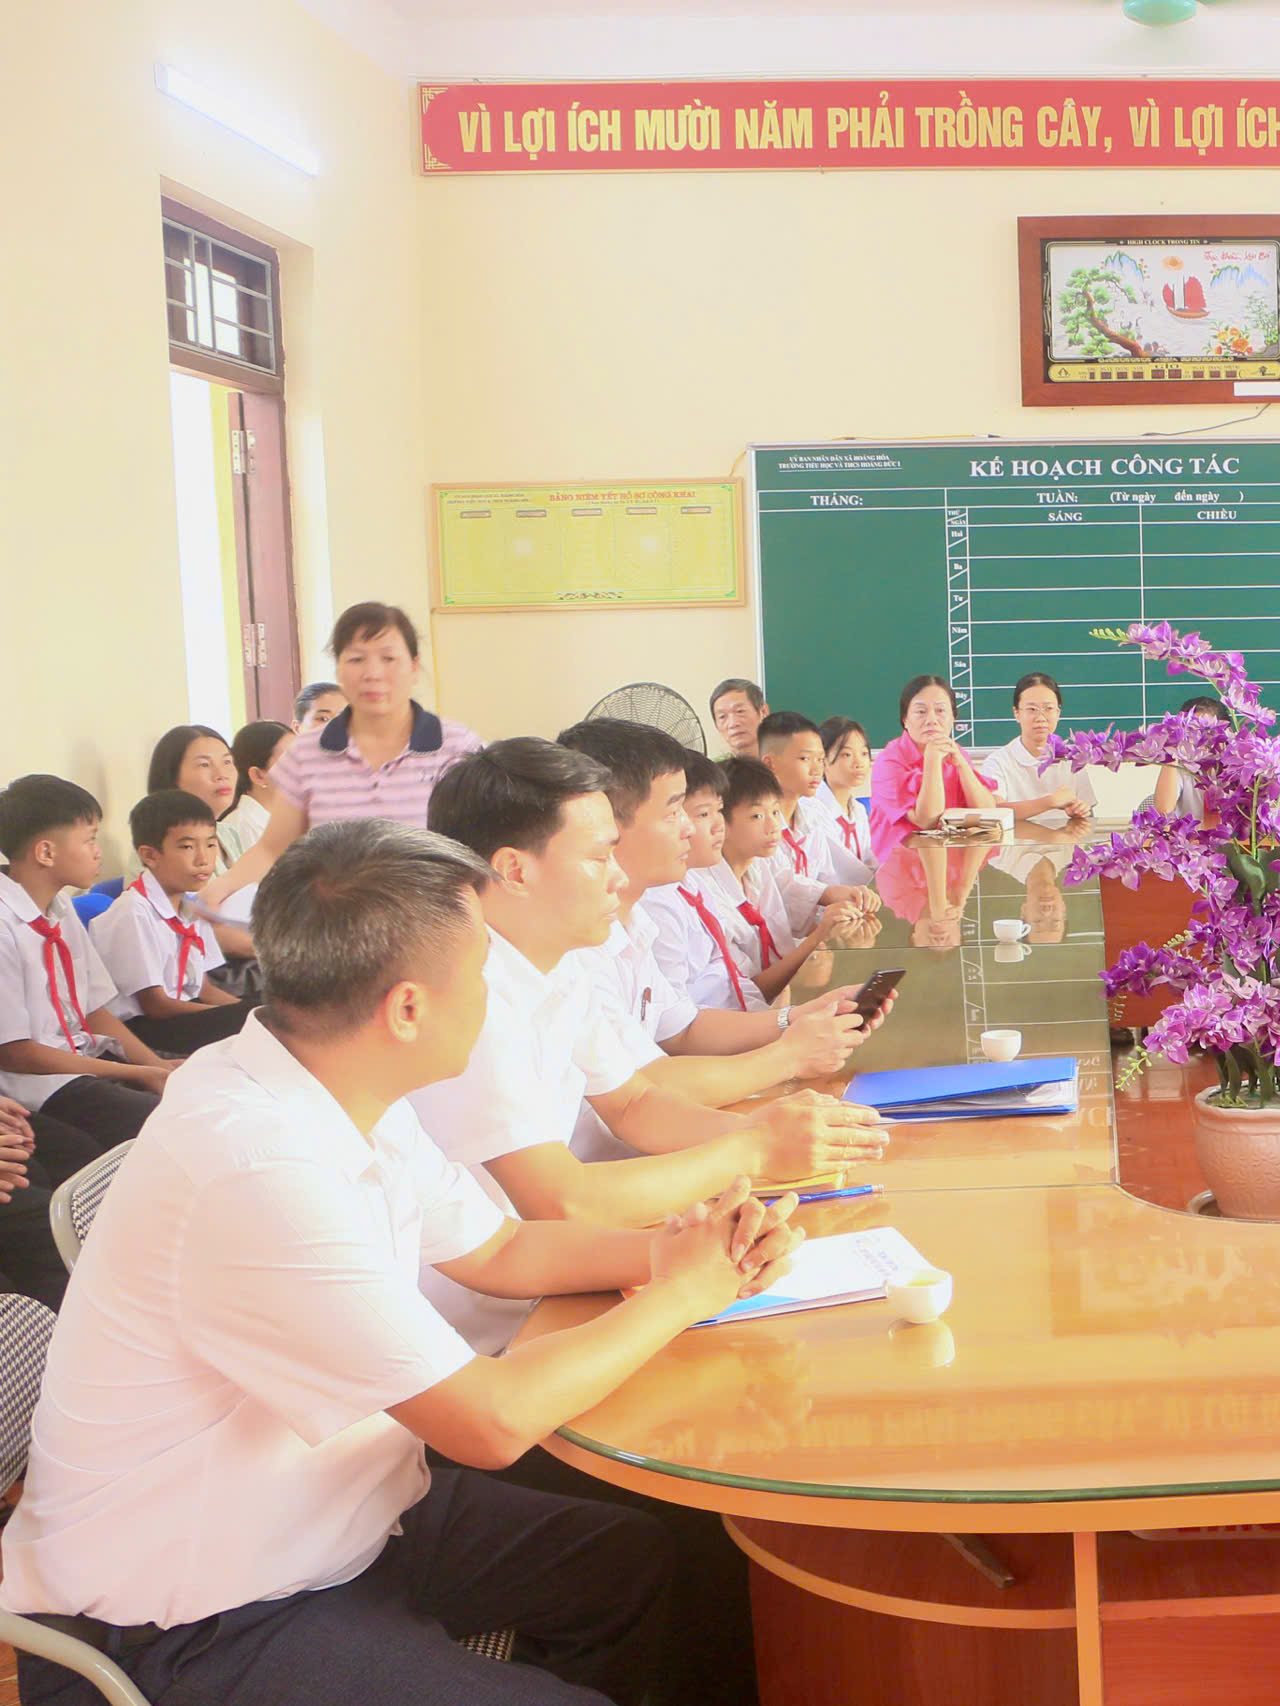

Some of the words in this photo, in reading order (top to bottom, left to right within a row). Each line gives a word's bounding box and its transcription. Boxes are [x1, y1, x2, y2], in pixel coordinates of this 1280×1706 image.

[458, 103, 492, 153] VÌ
[504, 104, 556, 161] LỢI
[567, 100, 622, 152] ÍCH
[634, 98, 721, 152] MƯỜI
[735, 99, 814, 151] NĂM
[827, 90, 905, 150] PHẢI
[914, 90, 1024, 149] TRỒNG
[1036, 97, 1114, 154] CÂY,
[1128, 98, 1161, 148] VÌ
[1174, 100, 1225, 157] LỢI
[969, 455, 1005, 478] KẾ
[1010, 458, 1103, 482] HOẠCH
[1110, 453, 1186, 477] CÔNG
[1189, 453, 1241, 475] TÁC
[810, 491, 864, 507] THÁNG:
[1110, 491, 1131, 504] (Từ
[1132, 491, 1157, 505] ngày
[1174, 489, 1193, 502] đến
[1195, 491, 1220, 504] ngày
[1047, 510, 1083, 523] SÁNG
[1196, 508, 1238, 521] CHIỀU
